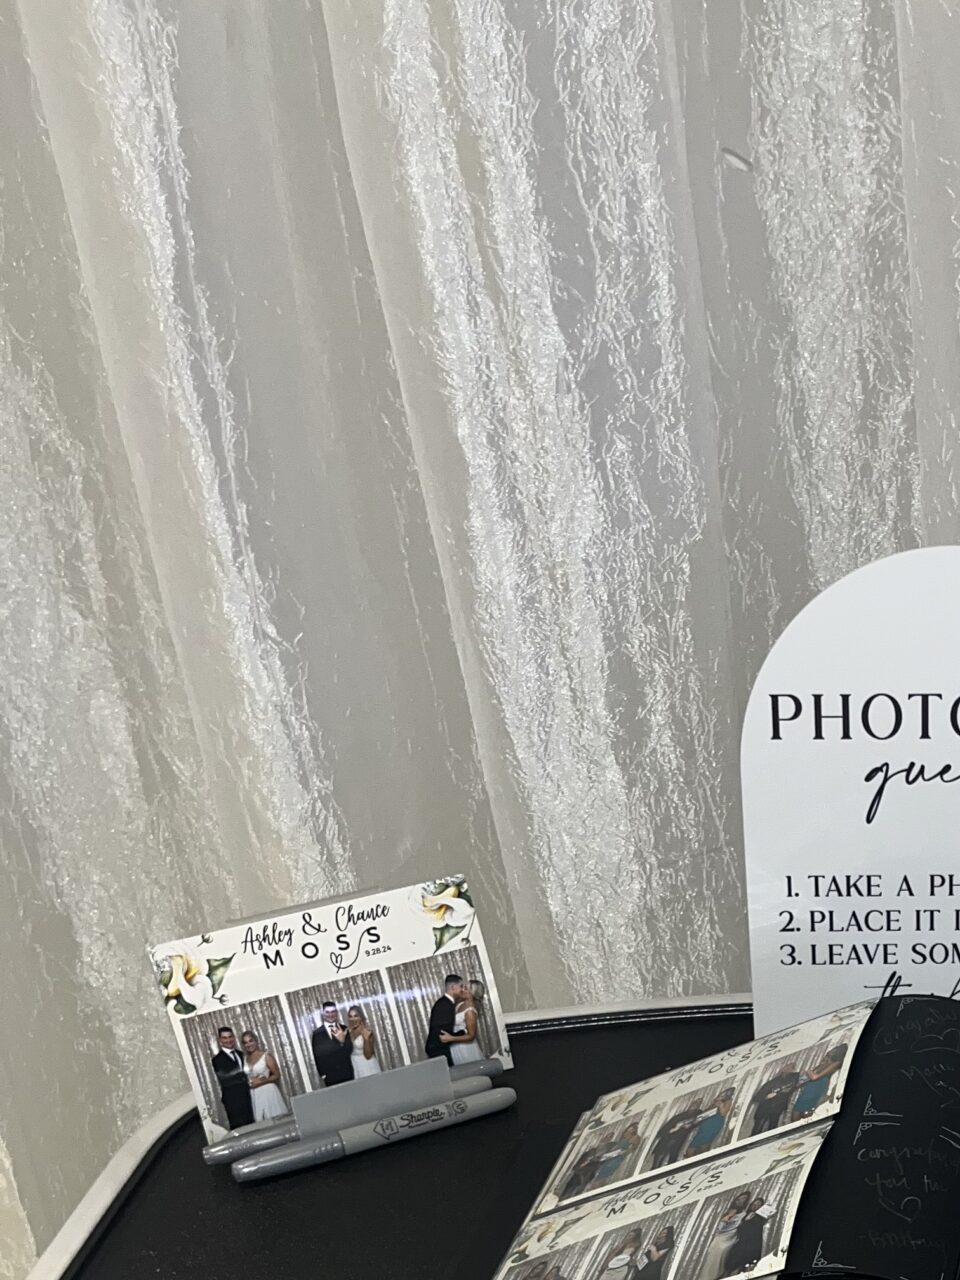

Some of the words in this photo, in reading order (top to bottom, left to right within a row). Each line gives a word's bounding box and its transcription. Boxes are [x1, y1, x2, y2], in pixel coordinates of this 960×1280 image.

[785, 875, 800, 898] 1.
[808, 874, 883, 898] TAKE
[897, 874, 915, 897] A
[241, 922, 294, 955] Ashley
[302, 912, 327, 935] &
[335, 904, 390, 931] Chance
[779, 910, 801, 933] 2.
[809, 909, 902, 932] PLACE
[914, 909, 941, 932] IT
[365, 945, 392, 957] 9.28.24
[780, 944, 802, 966] 3.
[810, 943, 899, 966] LEAVE
[400, 1107, 445, 1128] Sharpie
